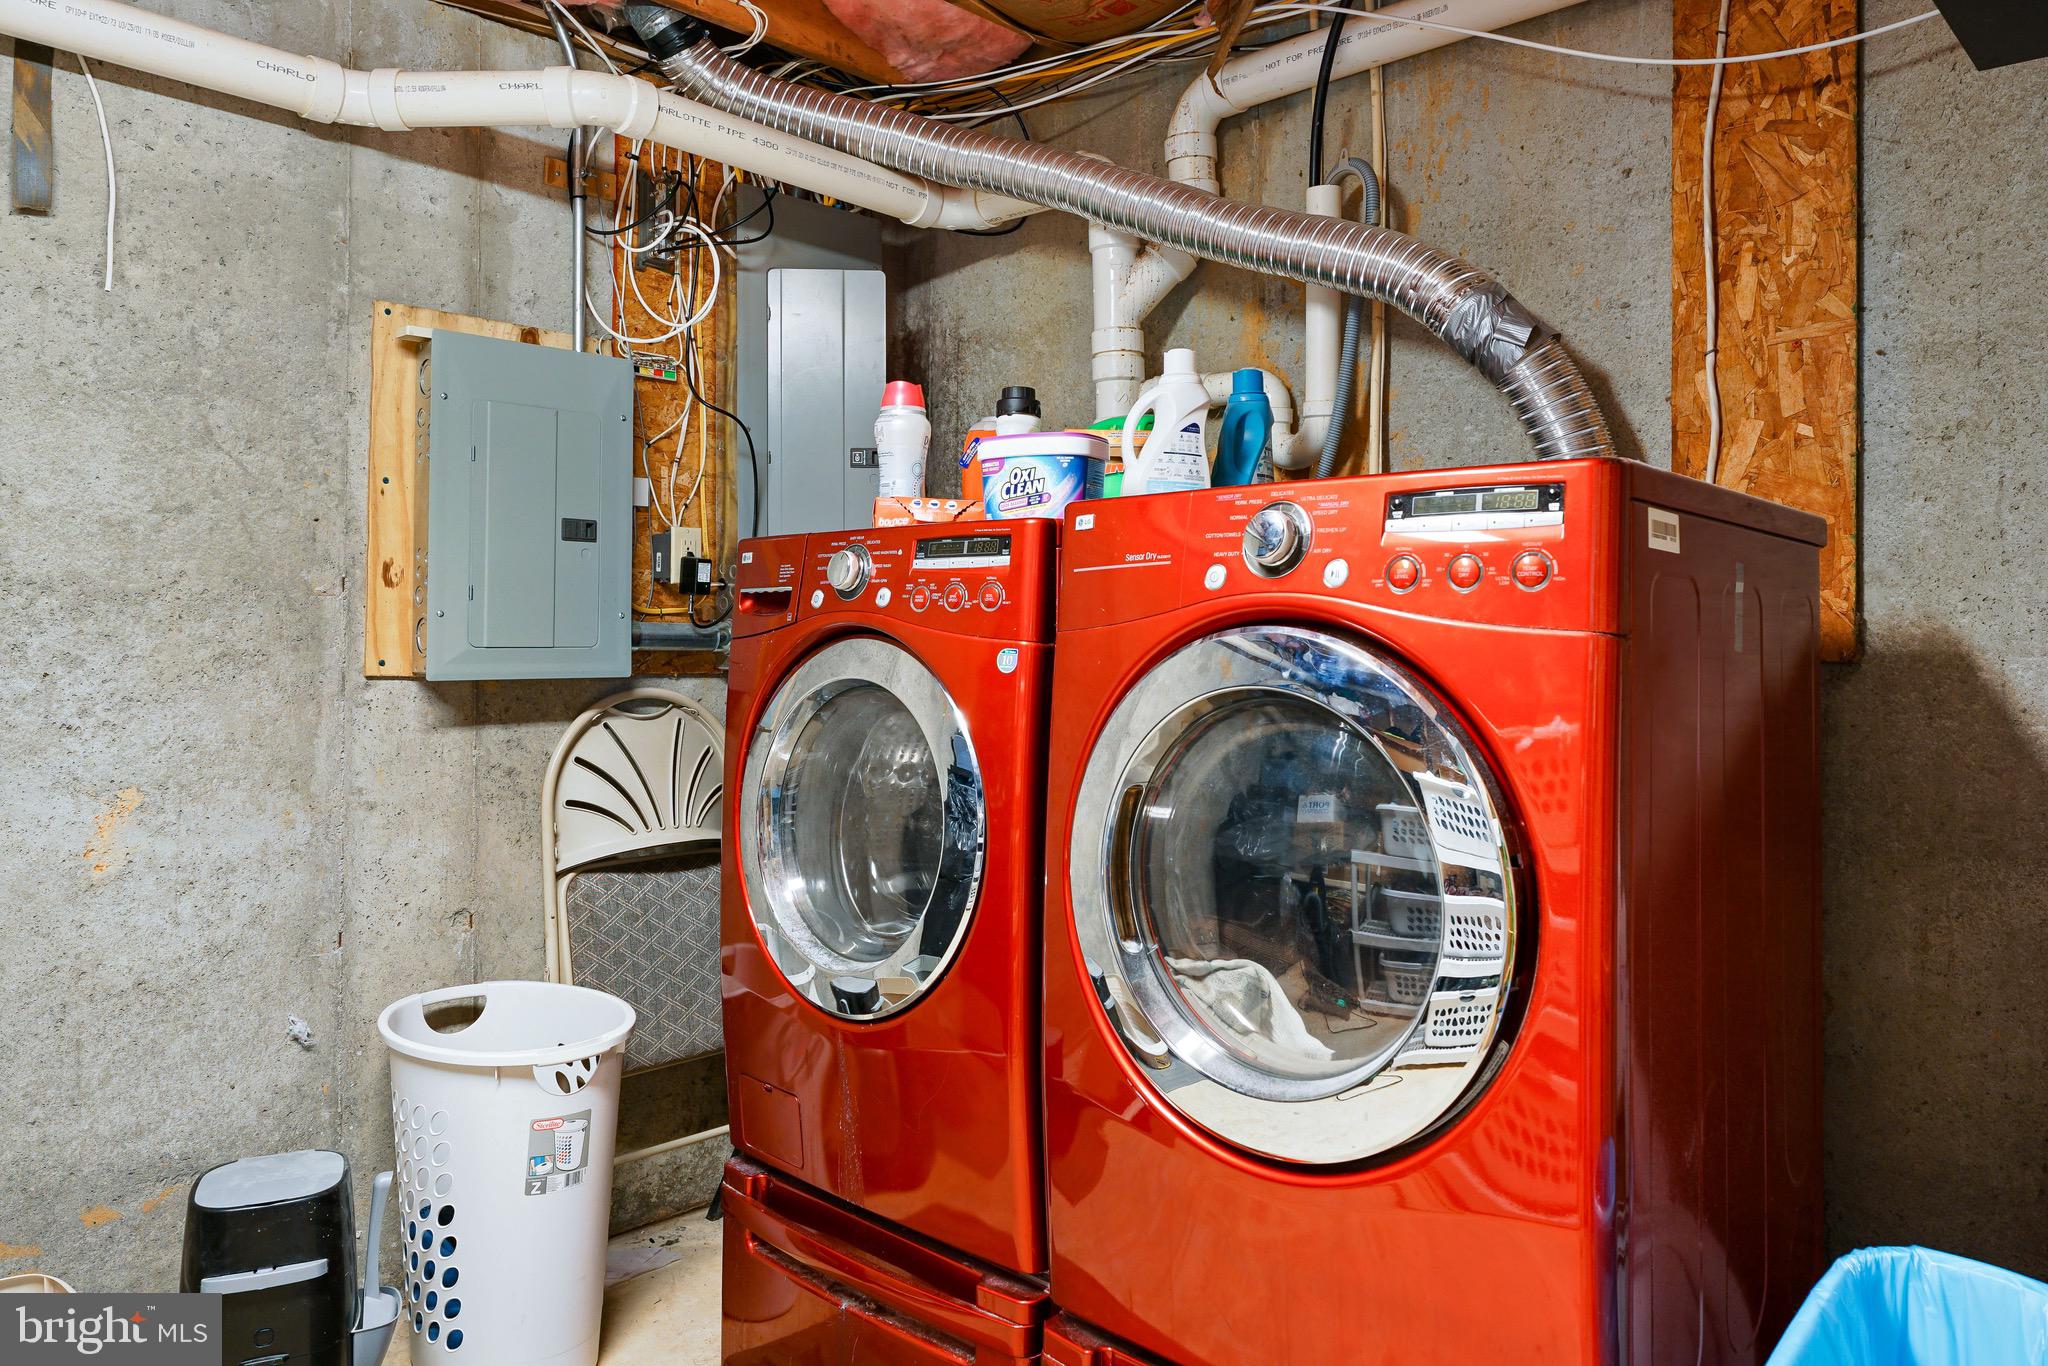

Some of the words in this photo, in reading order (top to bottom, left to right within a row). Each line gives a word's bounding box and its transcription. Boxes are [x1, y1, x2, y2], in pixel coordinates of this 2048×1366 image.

[256, 60, 315, 82] CHARLO
[1265, 59, 1281, 72] NOT
[1286, 52, 1303, 64] FOR
[499, 82, 544, 91] CHARL
[717, 124, 746, 140] PIPE
[752, 136, 779, 151] 4300
[1009, 467, 1036, 485] OXI
[1001, 477, 1046, 500] CLEAN
[1125, 553, 1144, 561] Sensor
[1146, 551, 1157, 561] Dry
